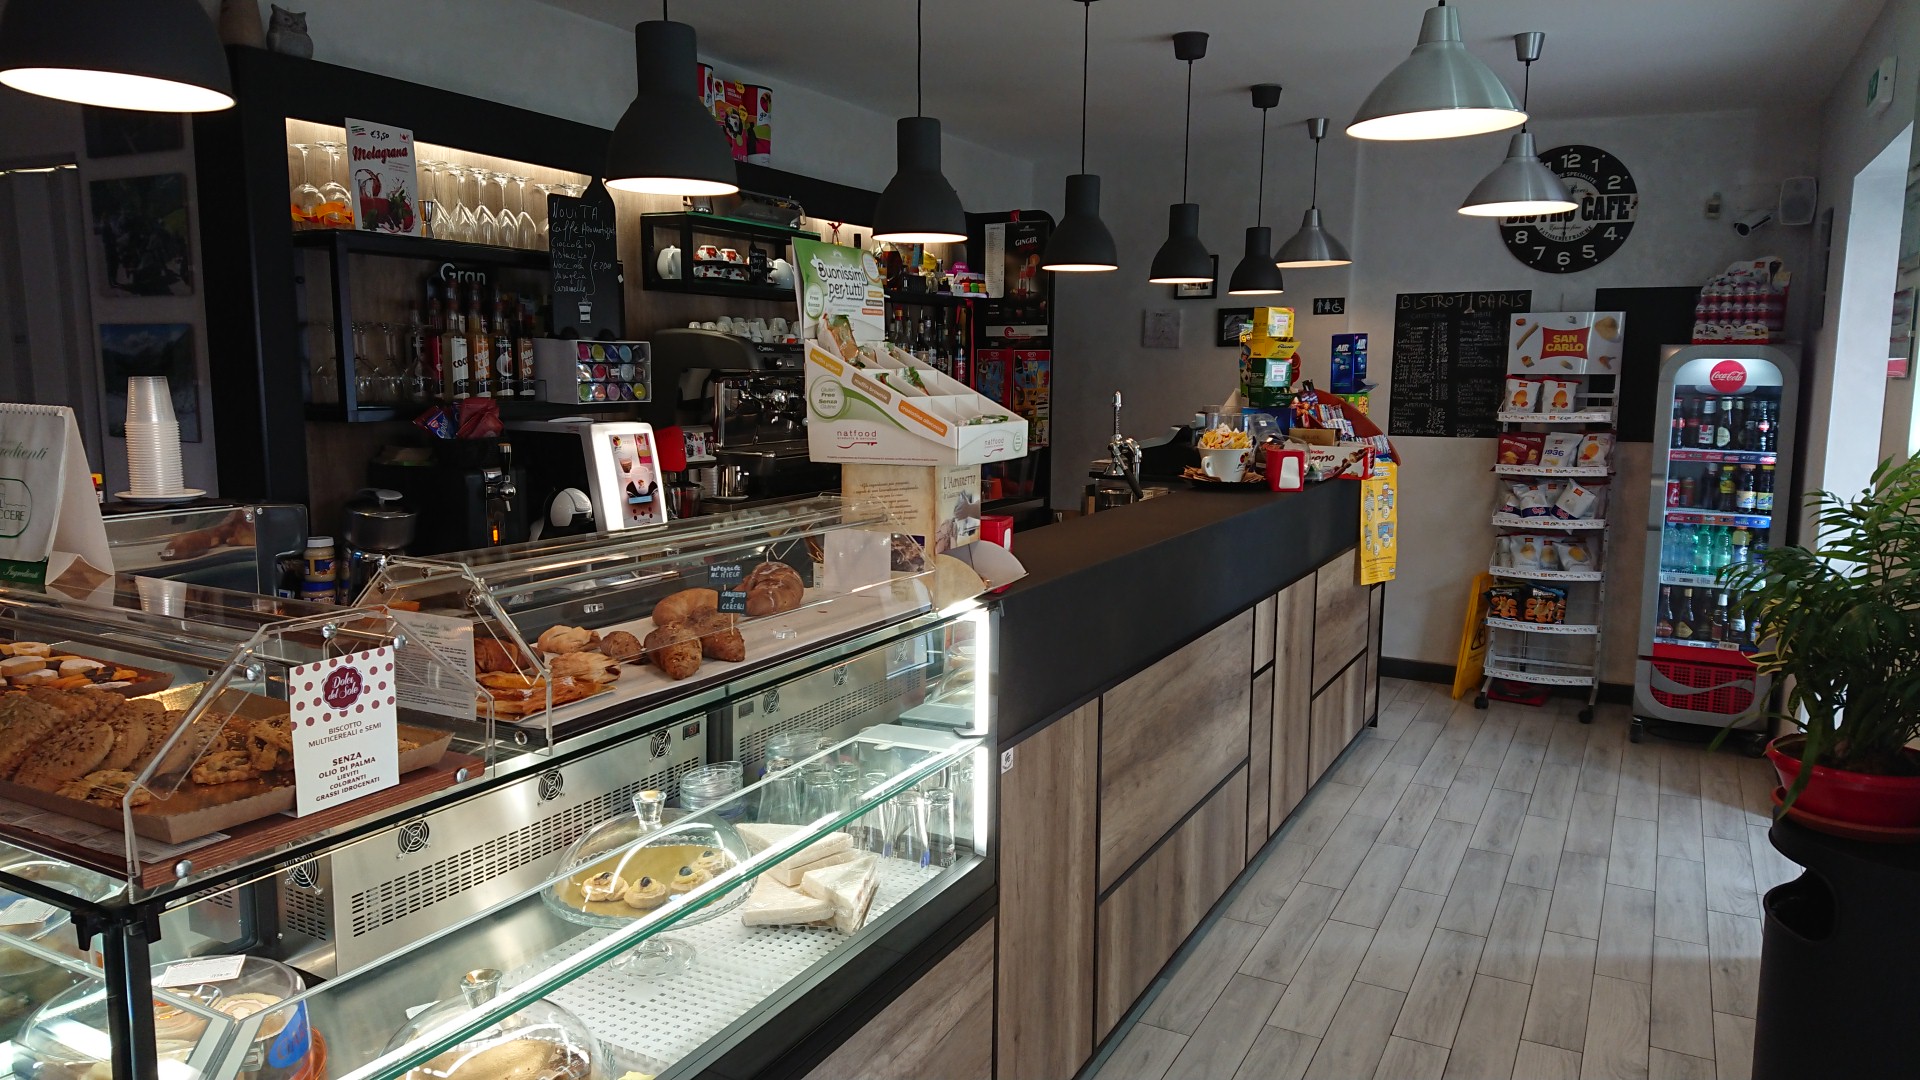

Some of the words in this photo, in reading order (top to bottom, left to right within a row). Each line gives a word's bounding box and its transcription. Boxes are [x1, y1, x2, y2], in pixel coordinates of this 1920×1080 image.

[353, 145, 408, 164] Melagrana
[1561, 154, 1581, 168] 12
[1592, 158, 1599, 173] 1
[1607, 175, 1621, 190] 2
[1581, 195, 1631, 221] CAFE
[1515, 231, 1528, 244] 8
[1604, 226, 1617, 240] 4
[1015, 236, 1038, 247] GINGER
[1533, 246, 1546, 260] 7
[1557, 252, 1571, 265] 6
[1582, 244, 1596, 258] 5
[818, 262, 867, 284] Buonissimi
[829, 282, 845, 298] per
[845, 282, 863, 297] tutti
[1399, 293, 1465, 310] BISTROT
[1478, 293, 1526, 309] PARIS
[1553, 334, 1578, 343] SAN
[1545, 343, 1584, 352] CARLO
[1711, 371, 1745, 382] Coca-Cola
[331, 673, 355, 690] Dolci
[327, 688, 339, 701] del
[339, 684, 359, 699] Sole
[328, 720, 362, 734] BISCOTTO
[308, 729, 358, 748] MULTICEREALI
[365, 722, 382, 732] SEMI
[332, 751, 362, 766] SENZA
[318, 768, 338, 779] OLIO
[340, 765, 348, 773] DI
[350, 757, 376, 770] PALMA
[337, 769, 359, 781] LIEVITI
[315, 789, 340, 802] GRASSI
[342, 776, 380, 793] IDROGENATI
[329, 774, 366, 790] COLORANTI
